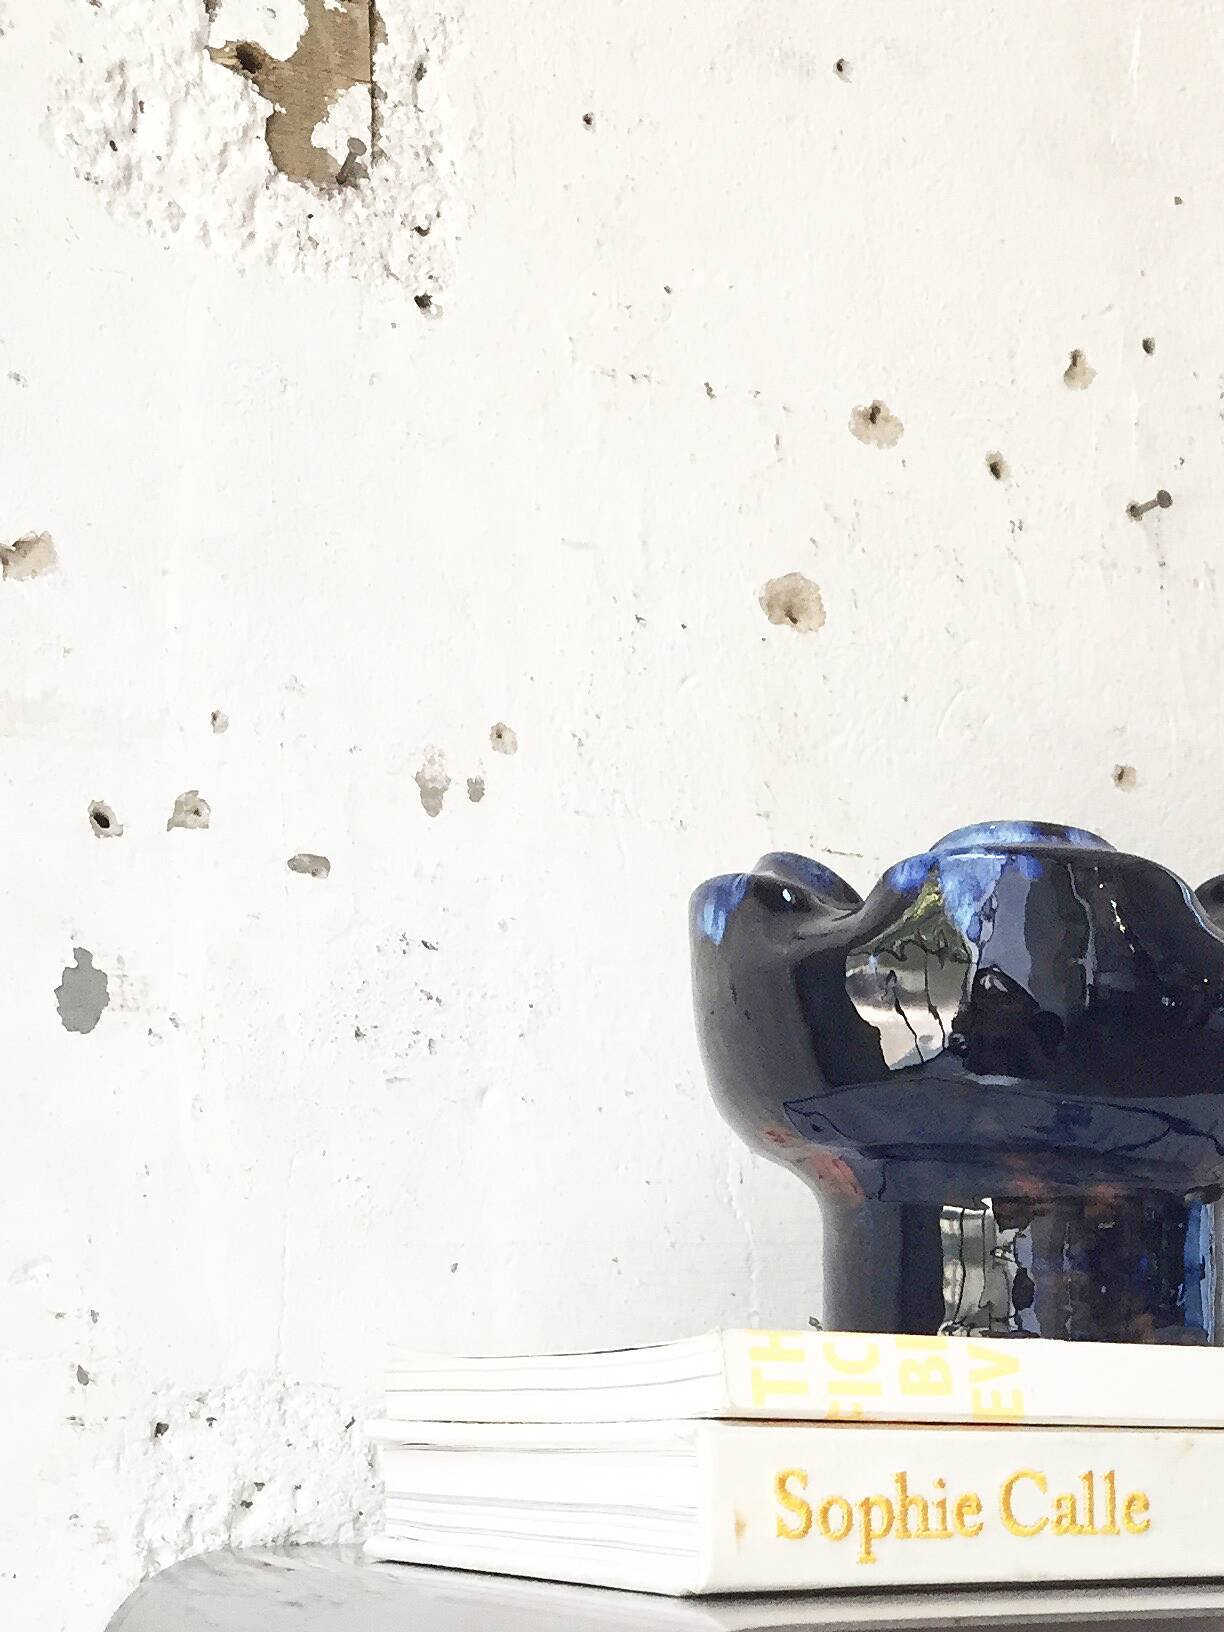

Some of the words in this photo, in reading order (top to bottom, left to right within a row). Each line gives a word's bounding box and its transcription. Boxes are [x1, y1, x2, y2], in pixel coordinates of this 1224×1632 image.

[967, 1344, 1024, 1421] EV
[774, 1467, 984, 1564] Sophie
[999, 1468, 1152, 1537] Calle
